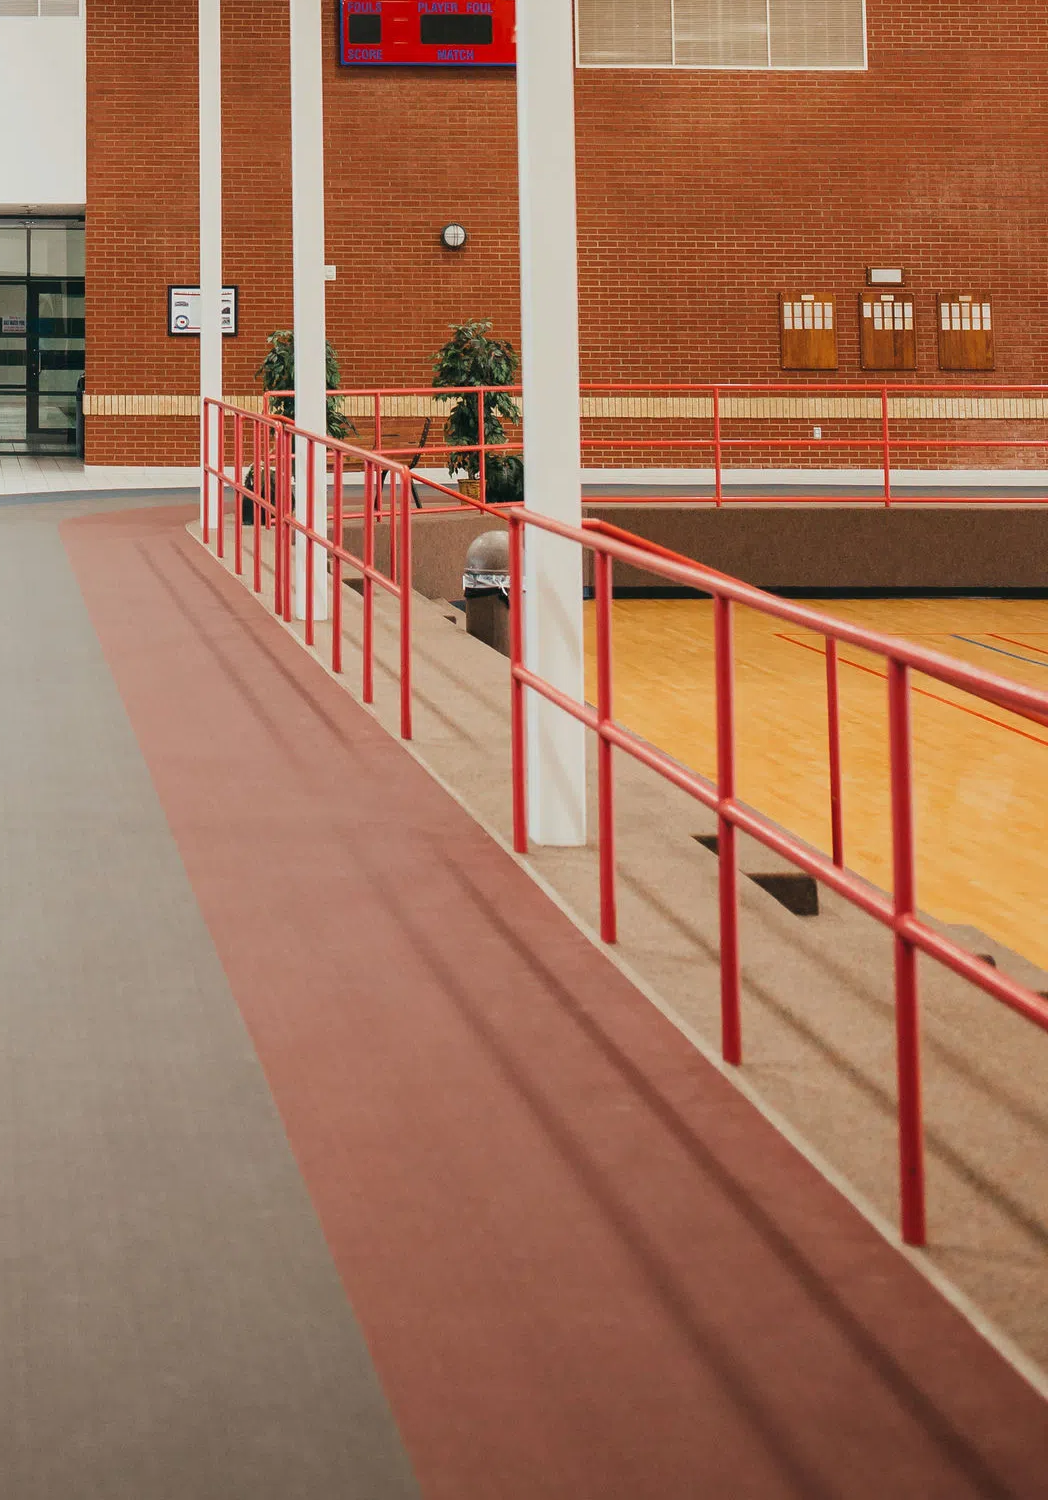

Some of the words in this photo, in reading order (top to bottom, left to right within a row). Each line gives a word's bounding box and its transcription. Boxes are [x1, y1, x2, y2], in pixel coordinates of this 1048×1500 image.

[348, 2, 382, 13] FOULS
[418, 2, 458, 13] PLAYER
[466, 2, 493, 13] FOUL
[348, 49, 383, 60] SCORE
[437, 49, 474, 60] MATCH
